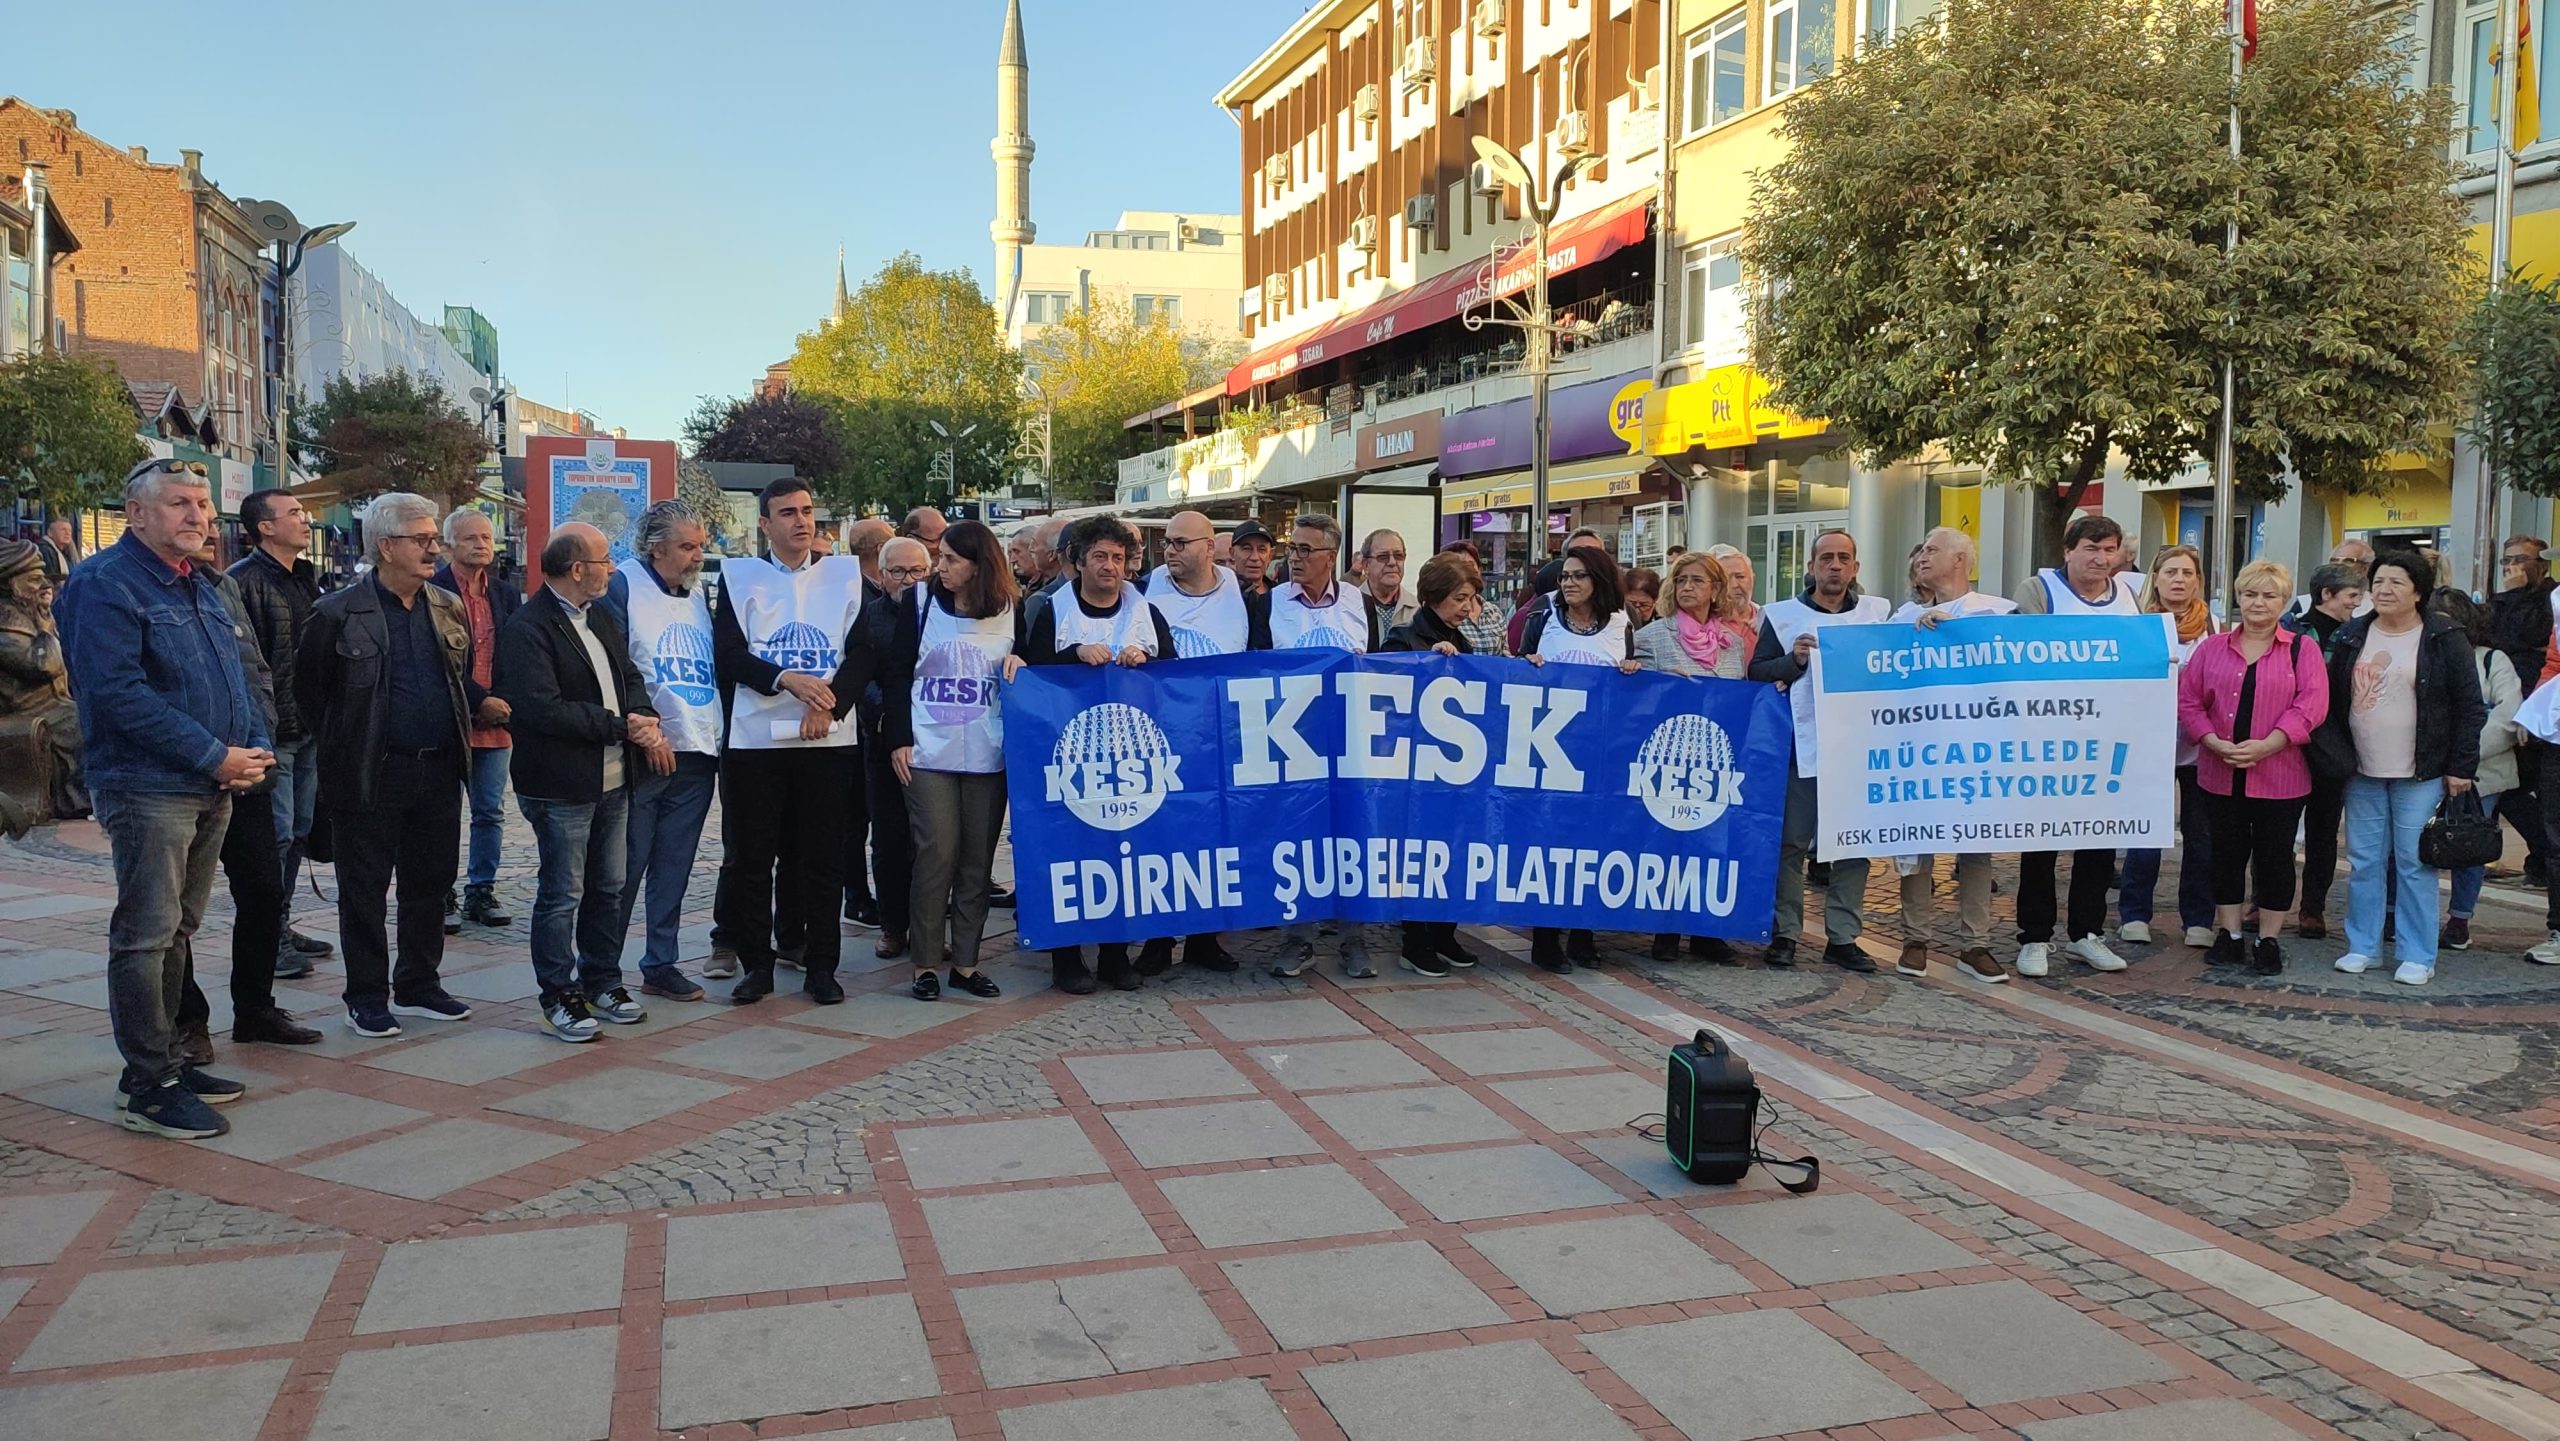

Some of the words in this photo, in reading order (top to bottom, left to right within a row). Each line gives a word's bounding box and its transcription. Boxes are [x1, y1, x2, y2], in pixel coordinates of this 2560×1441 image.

[1456, 286, 1481, 311] PİZZA
[1302, 343, 1324, 364] IZGARA
[1617, 399, 1642, 430] gra
[1712, 399, 1732, 424] Ptt
[1376, 430, 1414, 459] İLHAN
[1493, 491, 1511, 506] gratis
[1609, 477, 1631, 494] gratis
[1464, 496, 1479, 511] gratis
[760, 650, 838, 669] KESK
[1866, 634, 2120, 678] GEÇİNEMİYORUZ!
[920, 677, 993, 707] KESK
[1871, 697, 2019, 726] YOKSULLUĞA
[2027, 698, 2101, 720] KARŞI,
[1227, 672, 1587, 792] KESK
[1867, 739, 2099, 771] MÜCADELEDE
[1044, 755, 1183, 801] KESK
[1627, 762, 1745, 805] KESK
[1867, 769, 2097, 805] BİRLEŞİYORUZ
[1099, 801, 1138, 819] 1995
[1670, 804, 1701, 821] 1995
[1837, 829, 1873, 847] KESK
[1878, 822, 1946, 844] EDİRNE
[1952, 820, 2035, 844] ŞUBELER
[2040, 818, 2151, 838] PLATFORMU
[1050, 841, 1242, 923] EDİRNE
[1273, 837, 1450, 920] ŞUBELER
[1466, 842, 1739, 917] PLATFORMU
